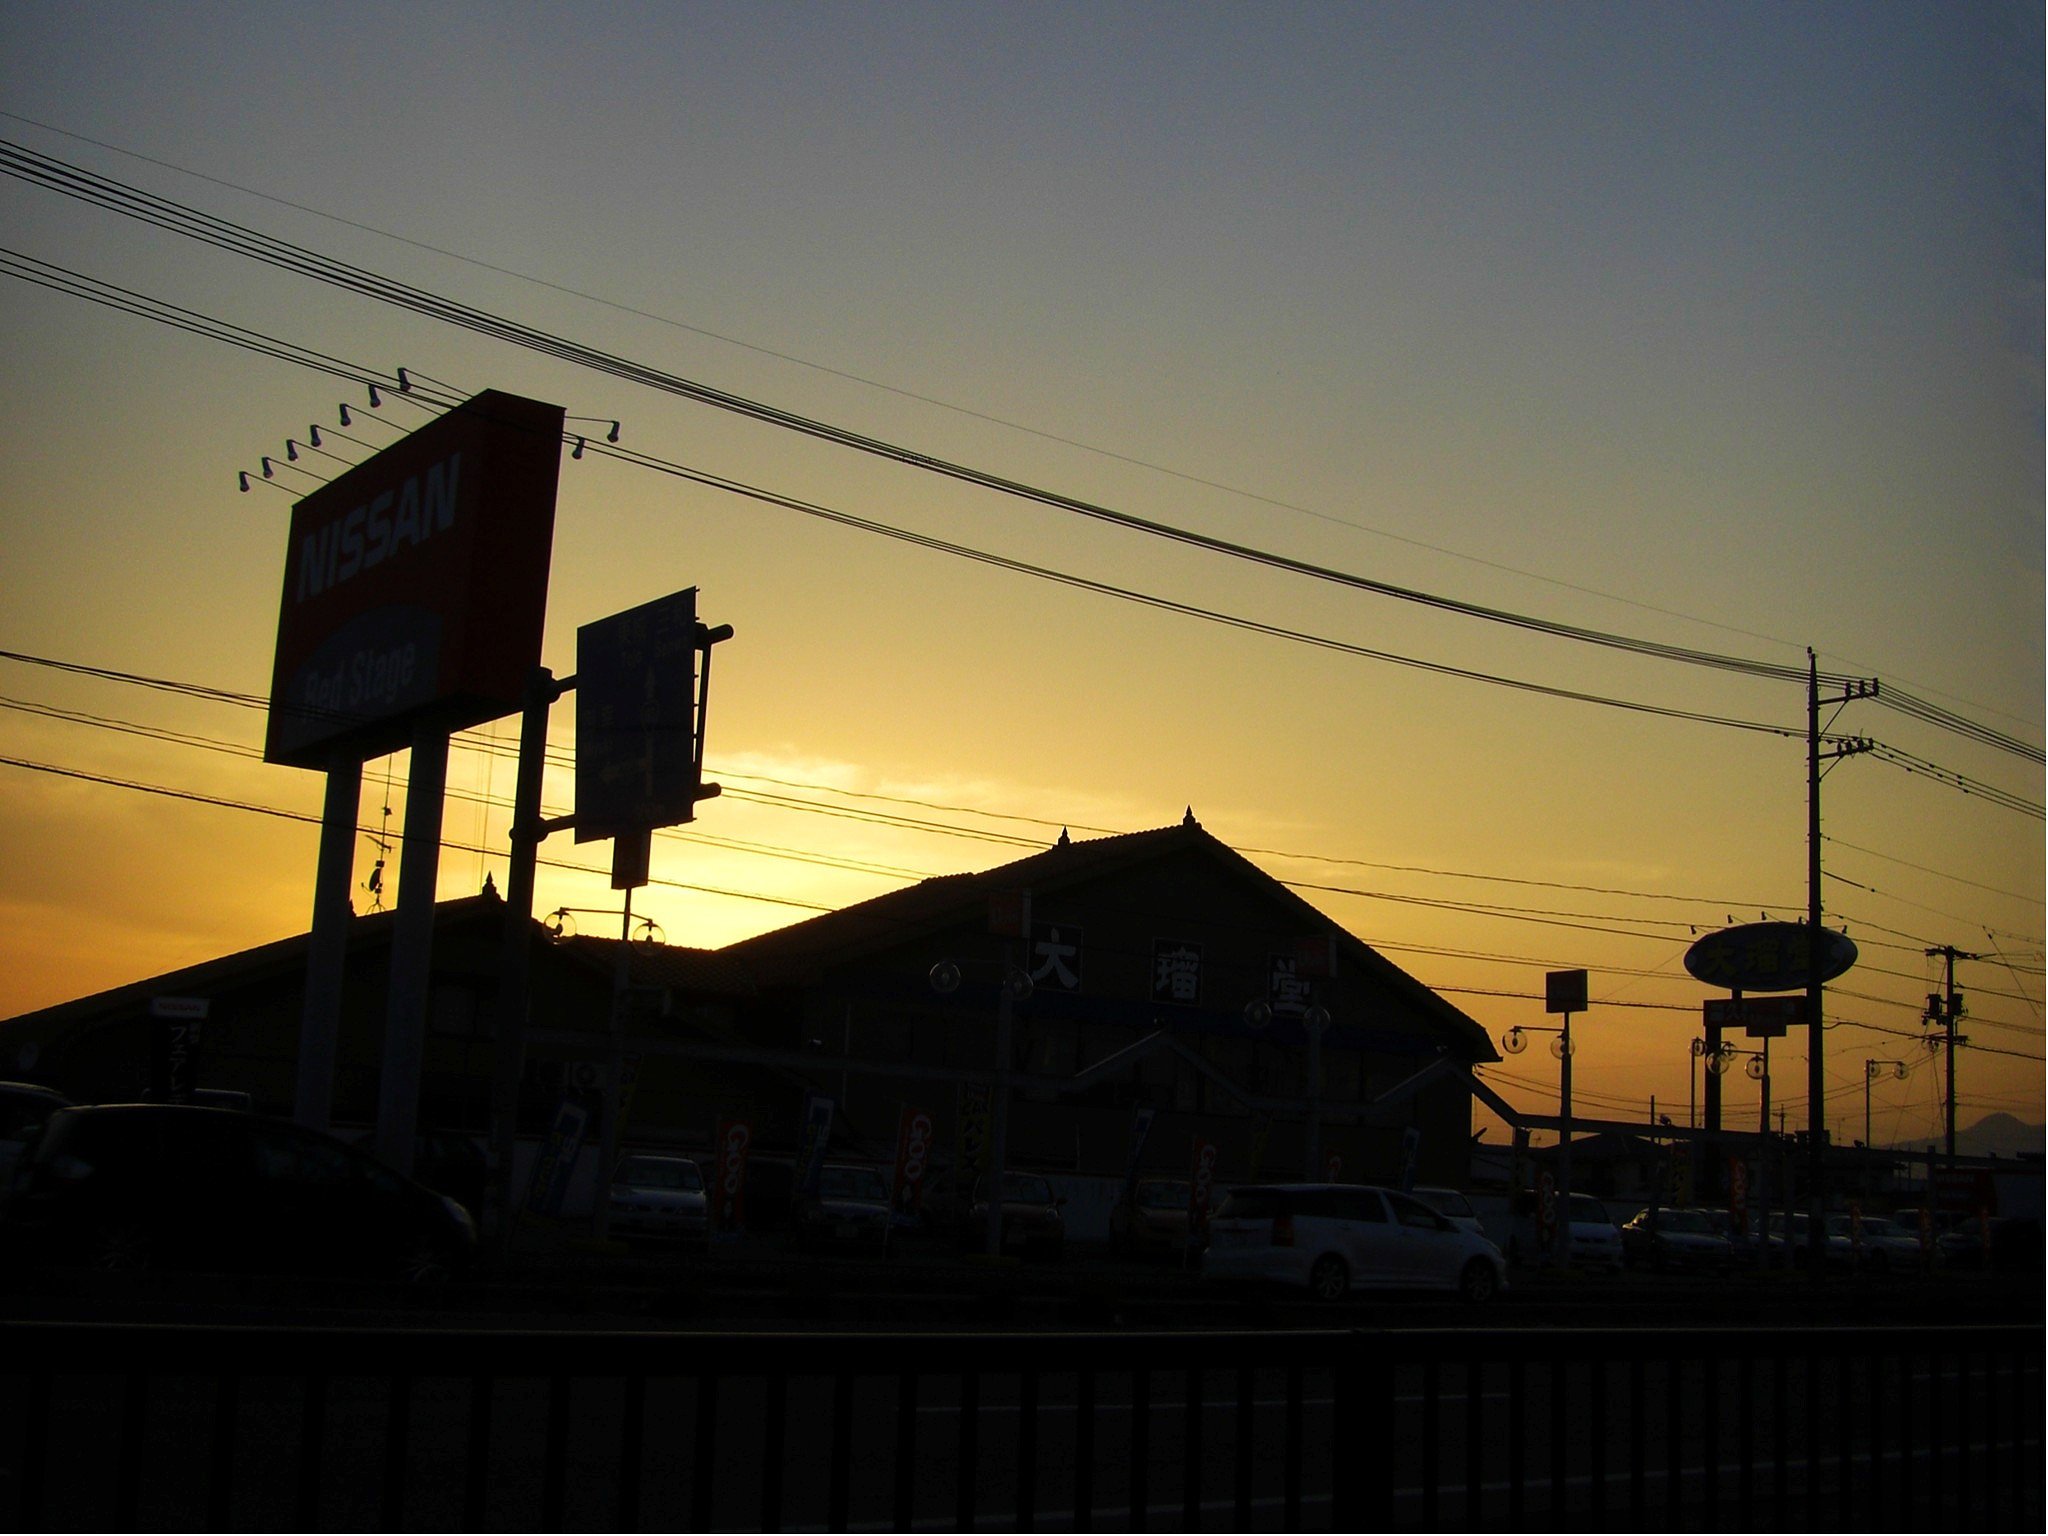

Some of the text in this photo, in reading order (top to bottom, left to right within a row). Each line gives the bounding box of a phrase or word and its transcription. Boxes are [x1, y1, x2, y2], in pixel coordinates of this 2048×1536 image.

[297, 452, 461, 603] NISSAN
[303, 641, 416, 716] Red Stage
